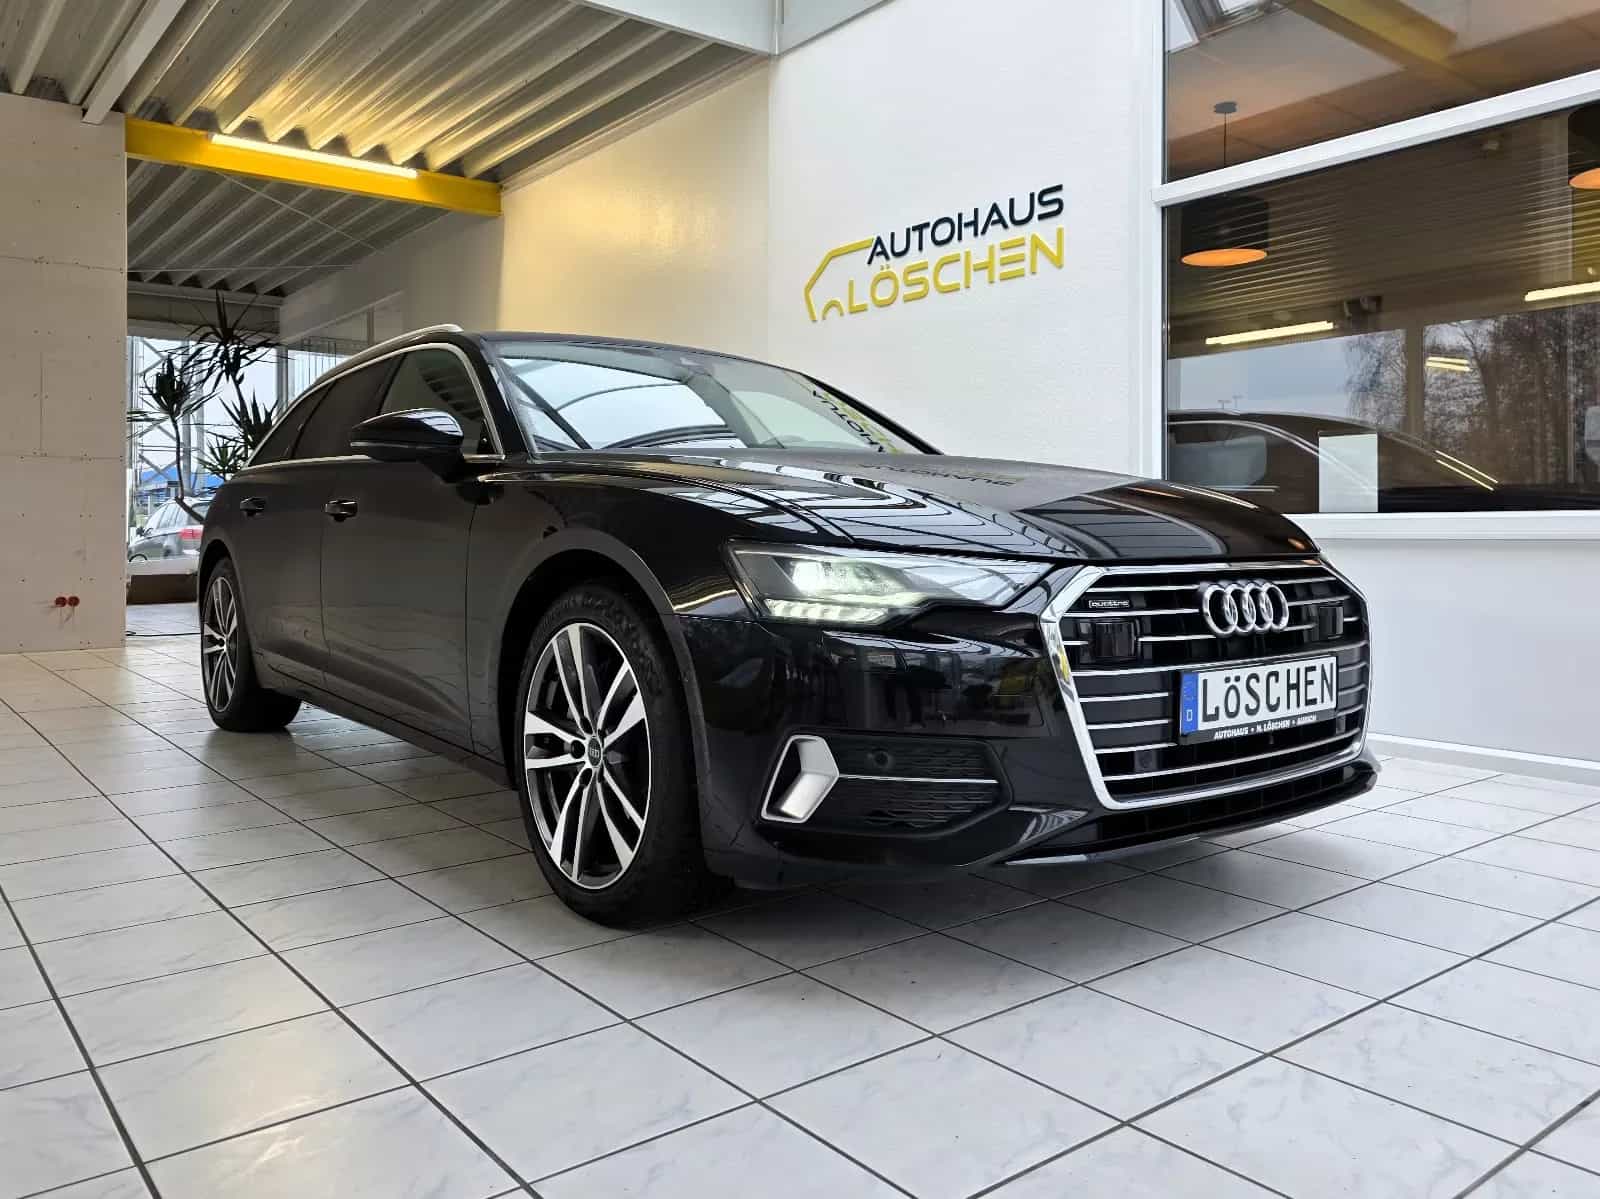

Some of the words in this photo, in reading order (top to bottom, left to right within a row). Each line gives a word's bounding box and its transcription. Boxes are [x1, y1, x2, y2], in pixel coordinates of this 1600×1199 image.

[867, 184, 1064, 265] AUTOHAUS
[848, 227, 1064, 314] LÖSCHEN
[1202, 662, 1334, 722] LÖSCHEN
[1213, 726, 1249, 740] AUTOHAUS
